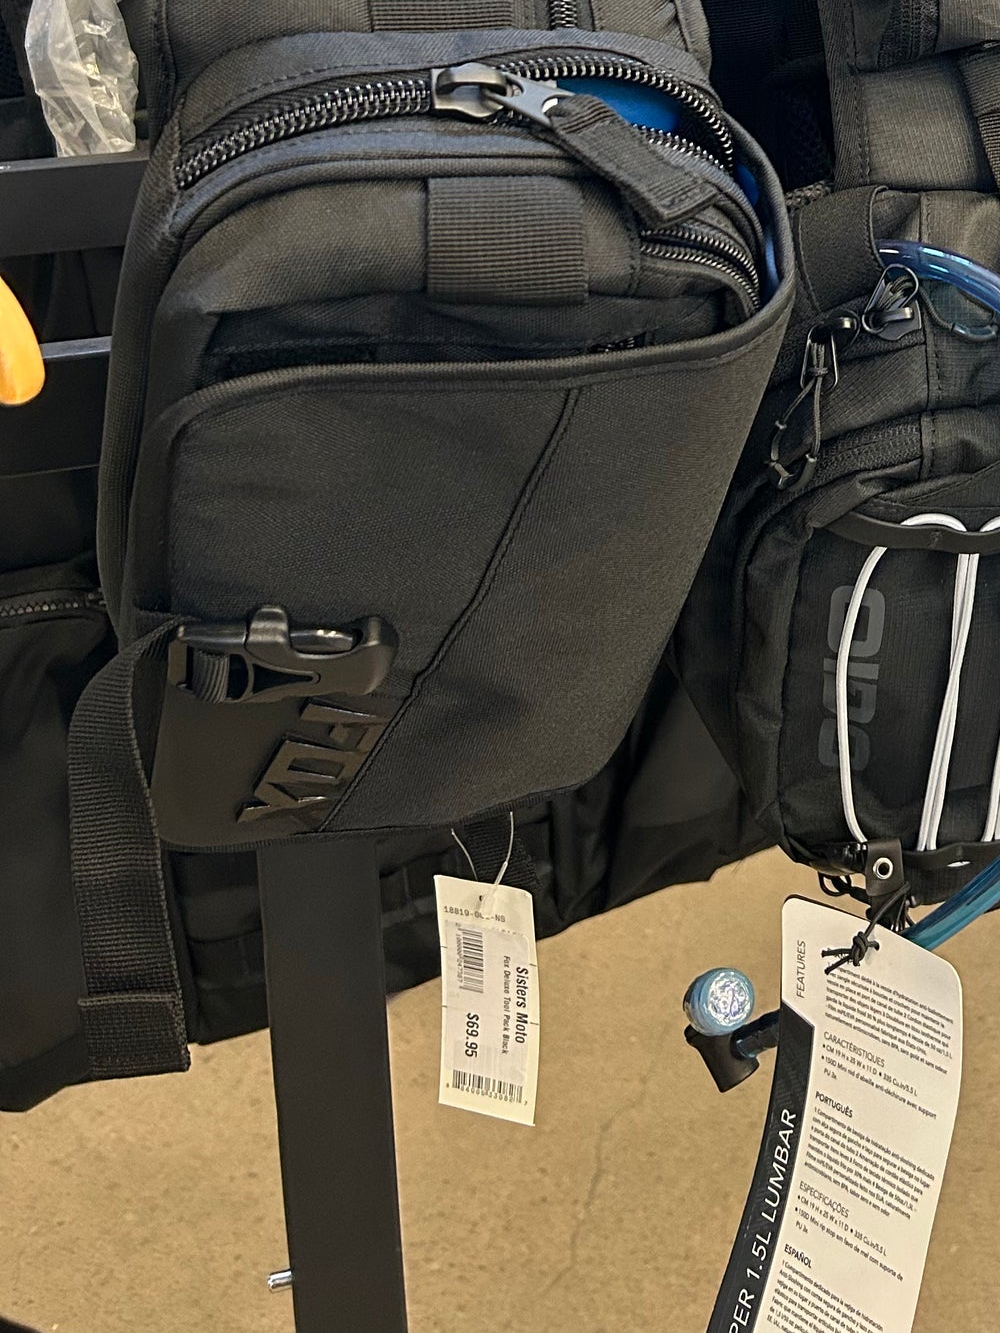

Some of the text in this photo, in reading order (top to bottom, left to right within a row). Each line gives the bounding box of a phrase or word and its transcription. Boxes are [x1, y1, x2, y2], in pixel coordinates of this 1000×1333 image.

[444, 906, 506, 923] 18819-0-NS
[503, 955, 511, 968] Fox
[796, 940, 806, 999] FEATURES
[503, 995, 511, 1011] Tool
[515, 966, 528, 1044] Sisters Moto
[465, 1012, 480, 1058] $69.95
[502, 1015, 511, 1032] Pack
[501, 1033, 510, 1054] Black
[824, 1032, 884, 1067] CARACTÉRISTIQUES
[816, 1092, 852, 1117] PORTUGUÊS
[746, 1231, 772, 1279] 1.5L
[762, 1108, 797, 1223] LUMBAR
[800, 1182, 848, 1217] ESPECIFICAÇÕES
[785, 1244, 811, 1268] ESPAÑOL
